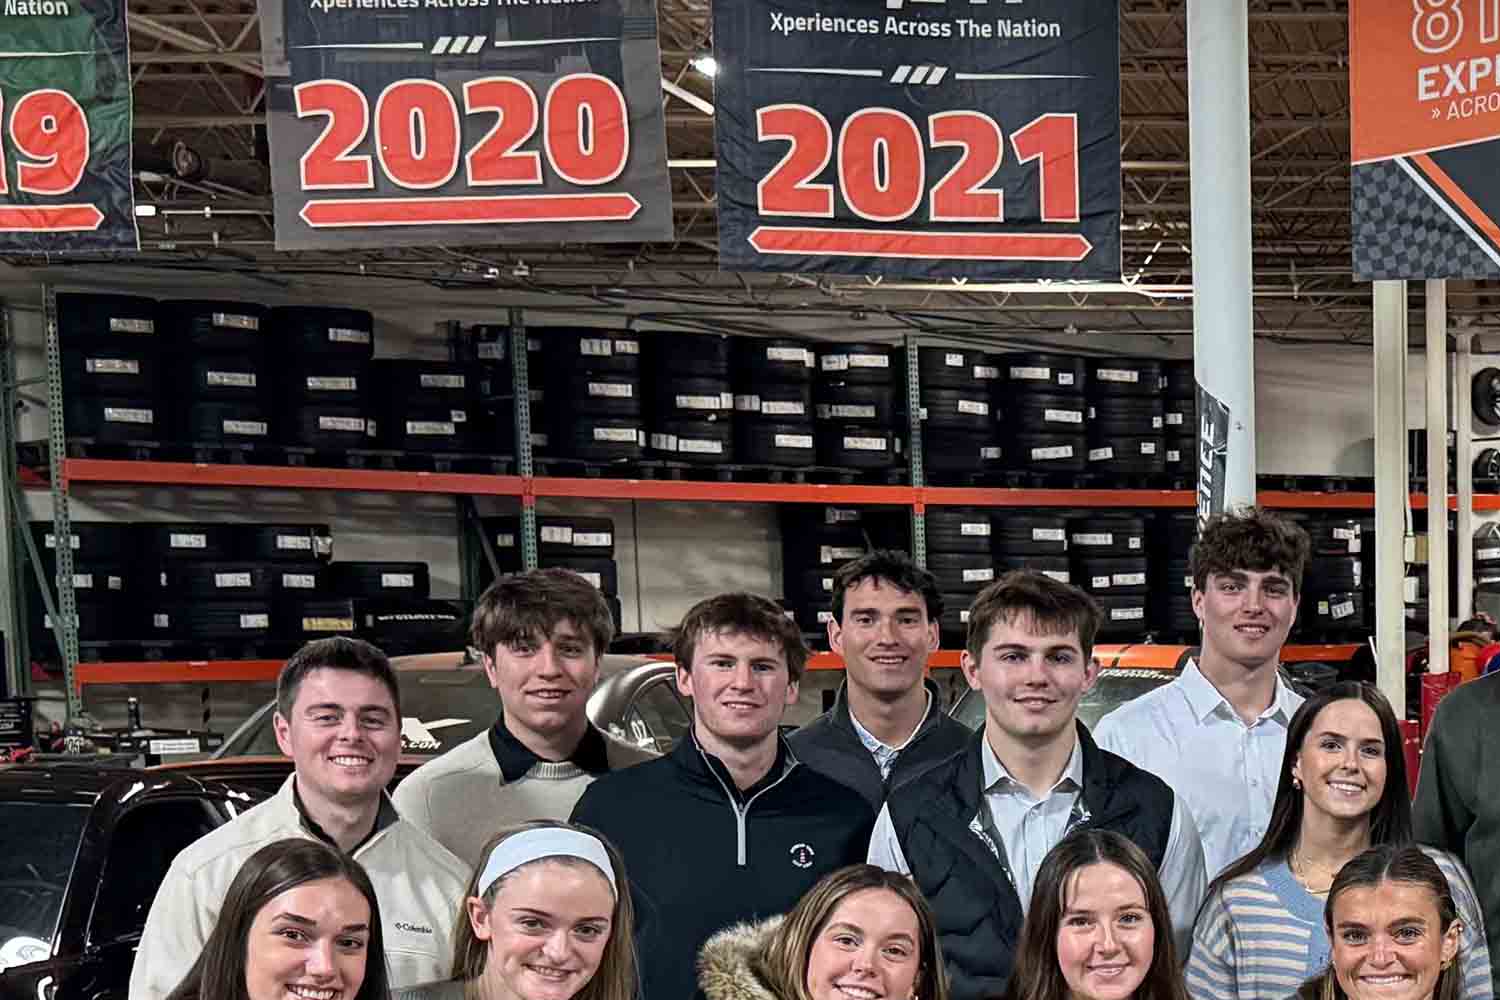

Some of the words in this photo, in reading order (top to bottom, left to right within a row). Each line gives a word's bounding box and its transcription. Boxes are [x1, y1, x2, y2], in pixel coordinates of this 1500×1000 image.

[4, 0, 69, 16] Nation
[769, 12, 879, 36] Xperiences
[884, 16, 951, 37] Across
[956, 19, 992, 38] The
[997, 19, 1061, 38] Nation
[0, 86, 90, 195] 9
[295, 74, 629, 191] 2020
[756, 103, 1080, 223] 2021
